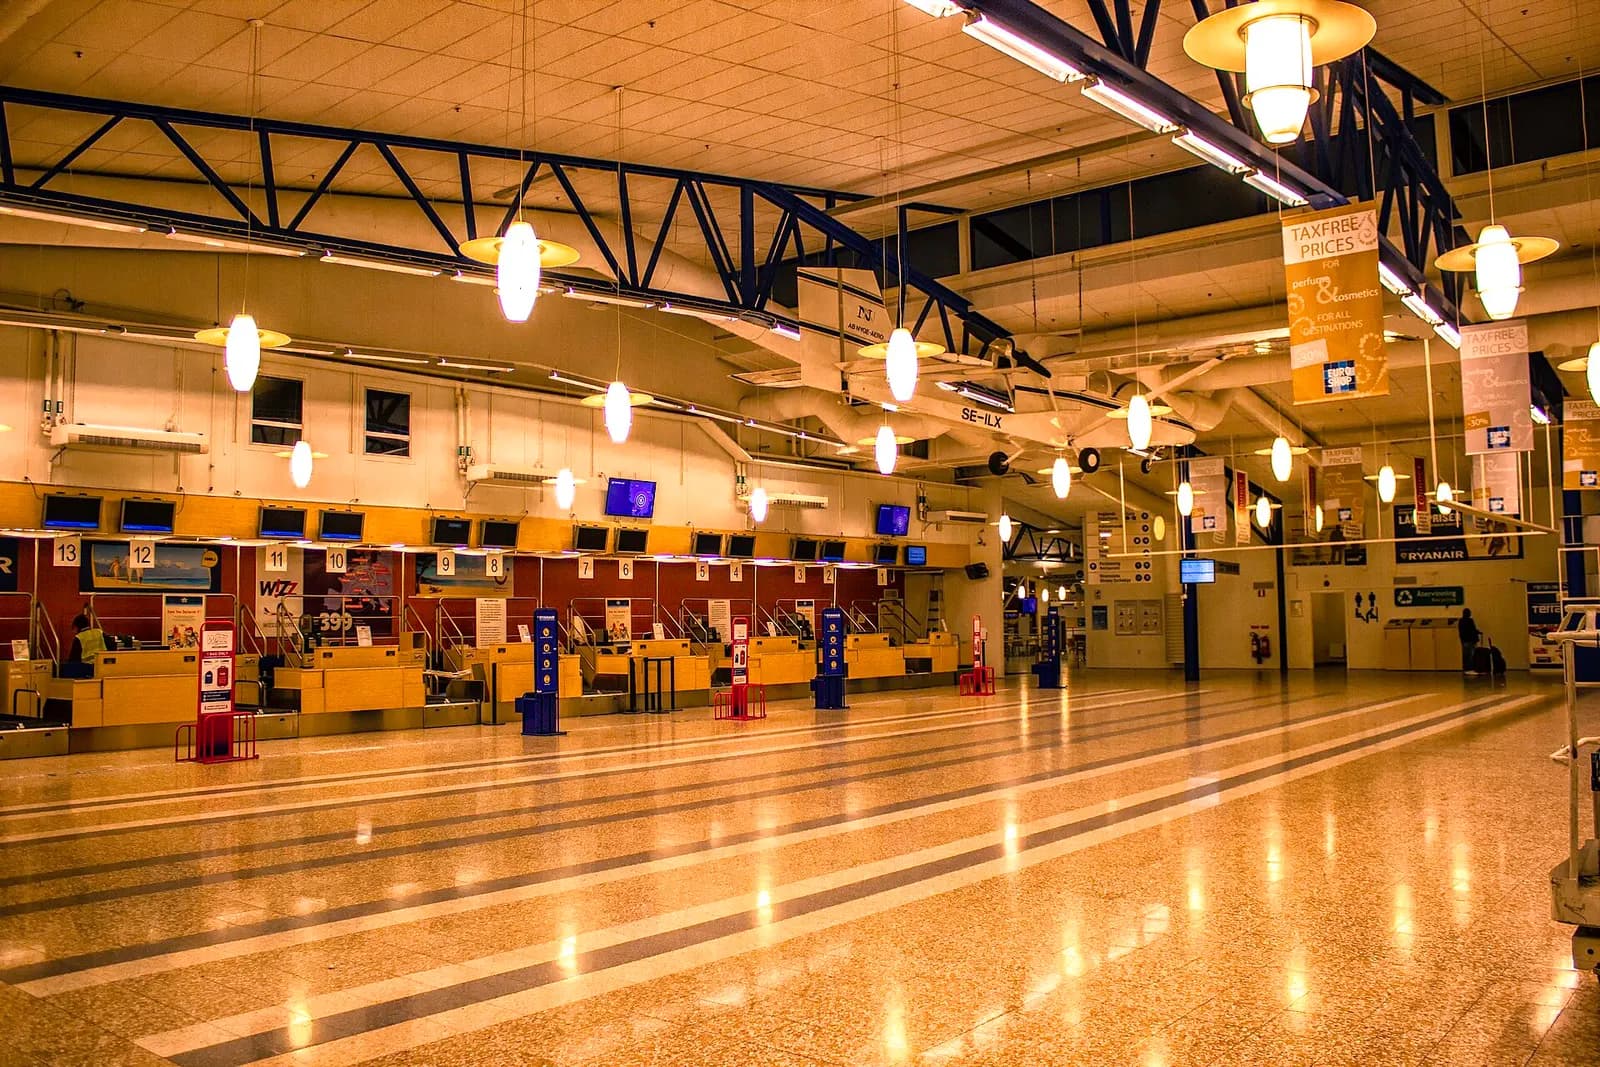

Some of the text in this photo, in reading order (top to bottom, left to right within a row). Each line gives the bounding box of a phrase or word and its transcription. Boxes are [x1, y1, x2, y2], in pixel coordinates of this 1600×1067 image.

[1291, 215, 1360, 241] TAXFREE
[1300, 236, 1354, 258] PRICES
[1322, 259, 1340, 270] FOR
[1316, 276, 1339, 304] &
[1334, 288, 1379, 302] cosmetics
[1317, 310, 1352, 322] FOR ALL
[847, 322, 855, 330] AB
[1303, 319, 1364, 336] DESTINATIONS
[1466, 328, 1516, 344] TAXFREE
[1472, 342, 1512, 355] PRICES
[1327, 366, 1355, 378] EURO
[1327, 376, 1353, 387] SHOP
[961, 407, 1002, 428] SE-ILX
[57, 543, 77, 562] 13
[134, 546, 151, 564] 12
[271, 551, 283, 567] 11
[1408, 550, 1464, 560] RYANAIR
[329, 553, 344, 569] 10
[442, 557, 450, 571] 9
[491, 558, 498, 573] 8
[583, 561, 589, 576] 7
[623, 562, 629, 576] 6
[699, 565, 706, 578] 5
[733, 566, 739, 578] 4
[797, 568, 803, 580] 3
[826, 569, 832, 581] 2
[880, 572, 884, 583] 1
[319, 612, 353, 631] 399
